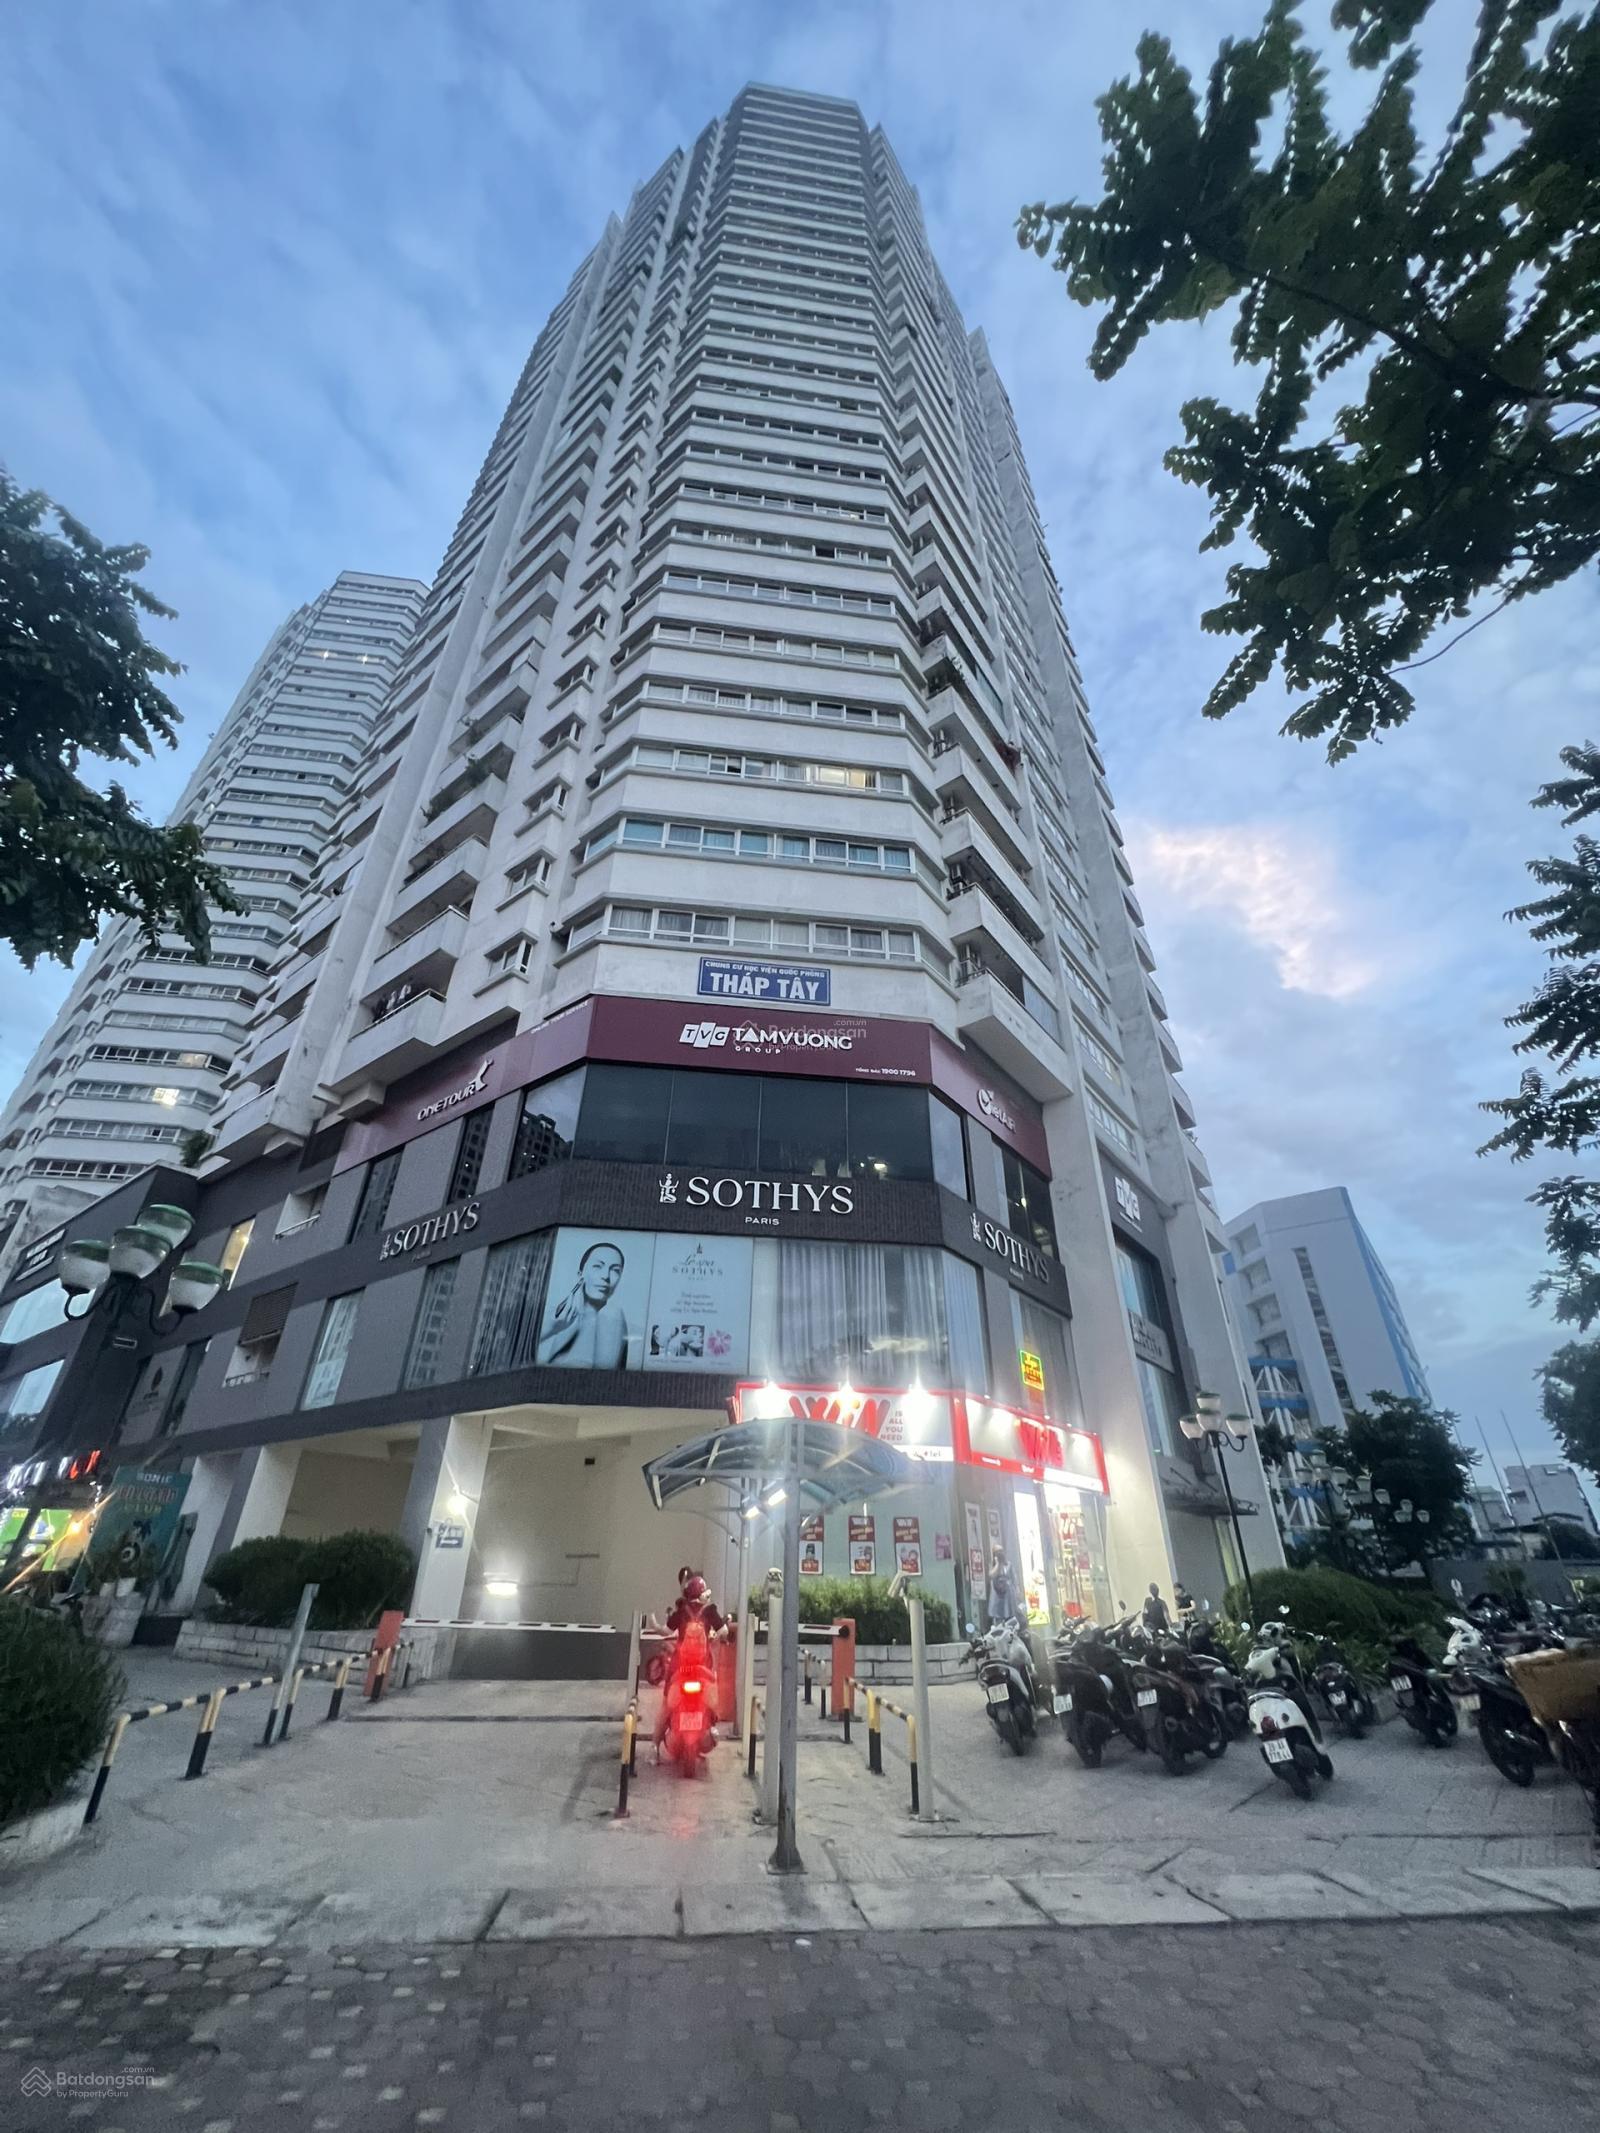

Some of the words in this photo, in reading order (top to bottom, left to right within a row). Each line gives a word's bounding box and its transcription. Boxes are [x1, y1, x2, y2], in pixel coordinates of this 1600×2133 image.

[705, 961, 731, 970] CHUNG
[710, 971, 770, 996] THÁP
[777, 977, 820, 1001] TÂY
[735, 1044, 781, 1055] GROUP
[417, 1084, 477, 1121] ONETOUR
[686, 1176, 854, 1214] SOTHYS
[745, 1216, 780, 1226] PARIS
[390, 1202, 480, 1258] SOTHYS
[984, 1222, 1049, 1284] SOTHYS
[889, 1417, 903, 1425] ALL
[885, 1425, 903, 1433] YOU
[881, 1433, 903, 1441] NEED
